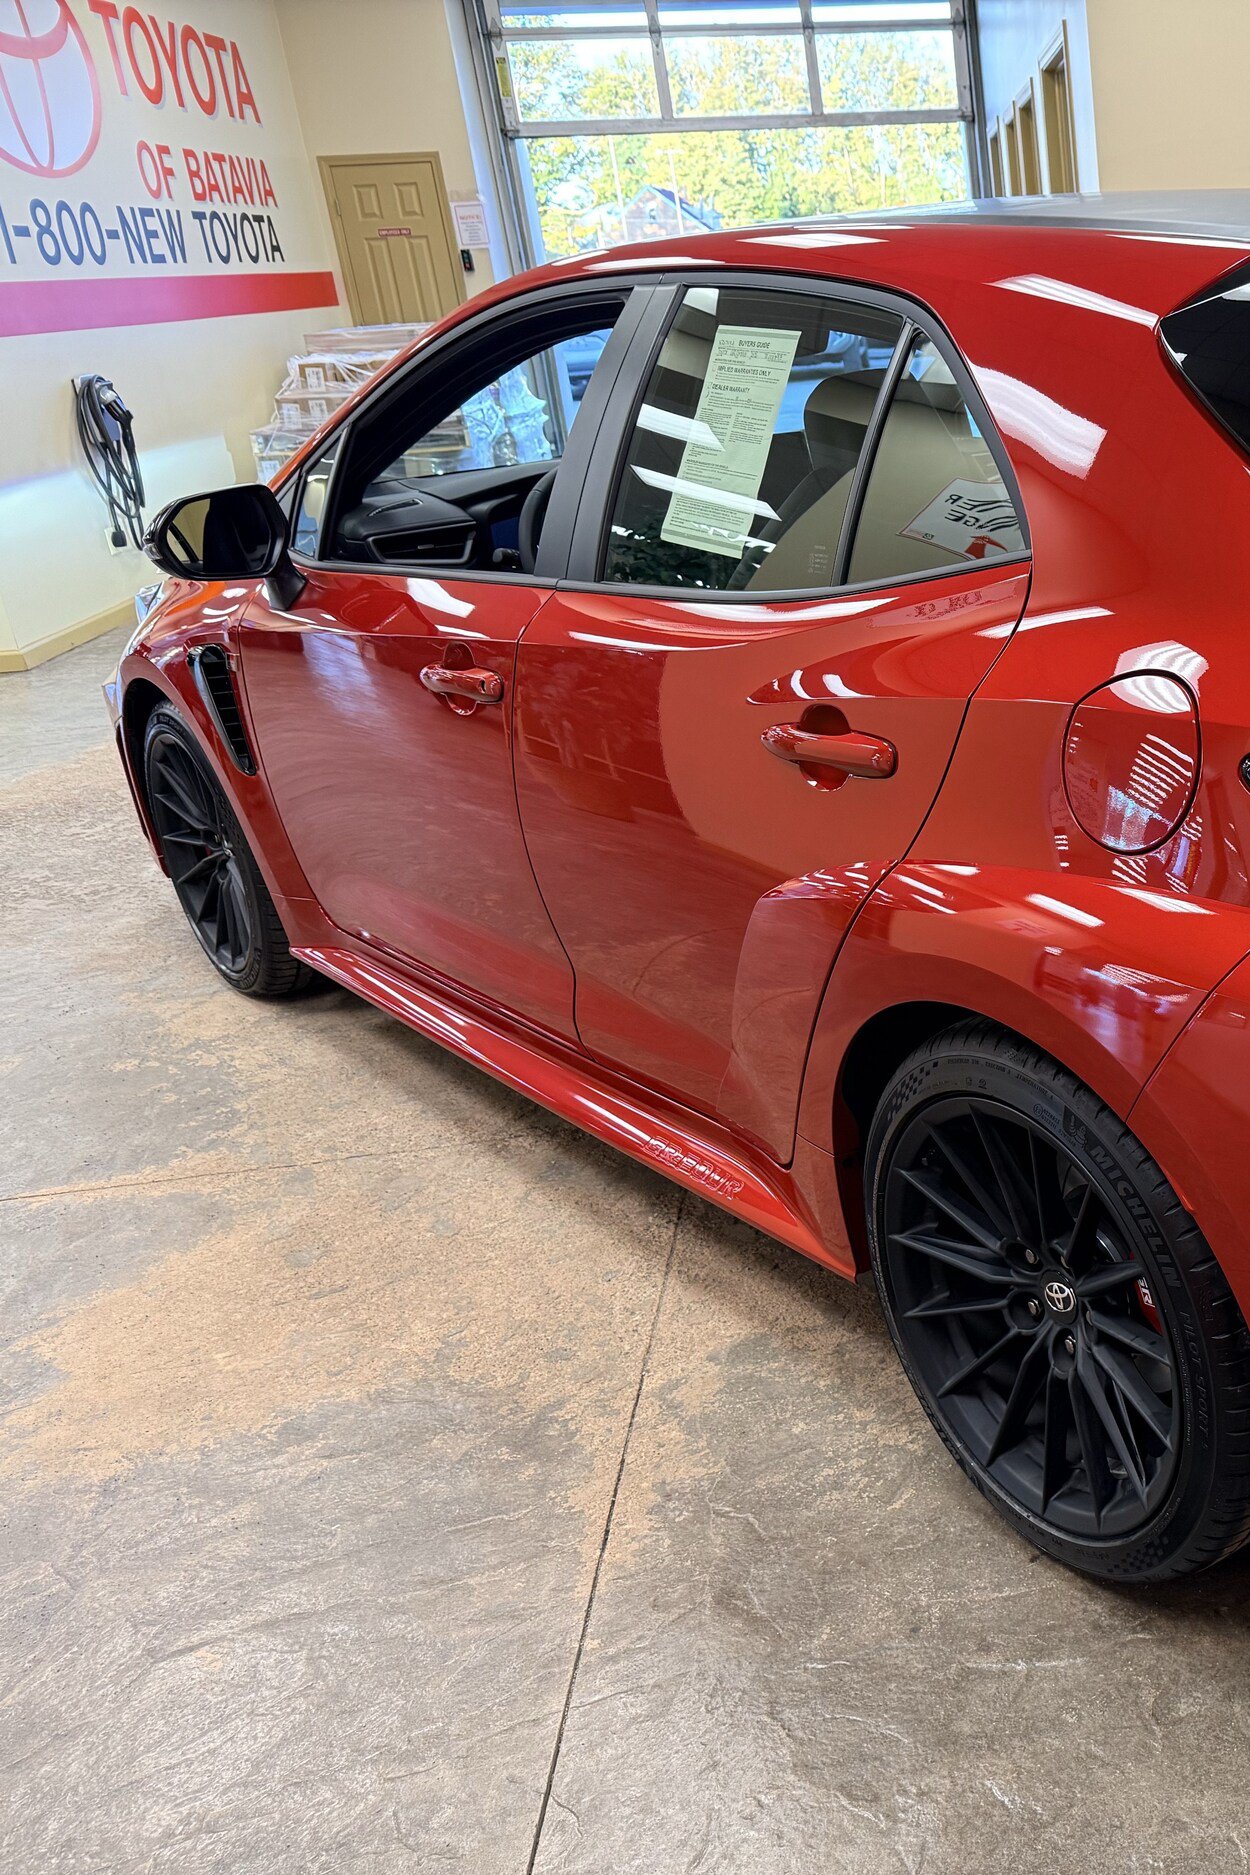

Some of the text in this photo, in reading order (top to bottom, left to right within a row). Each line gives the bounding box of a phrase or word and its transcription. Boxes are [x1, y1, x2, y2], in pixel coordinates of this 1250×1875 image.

[89, 0, 262, 125] TOYOTA
[137, 140, 278, 208] OF BATAVIA
[0, 198, 285, 266] 1-800-NEW TOYOTA
[1091, 1145, 1183, 1288] MICHELIN
